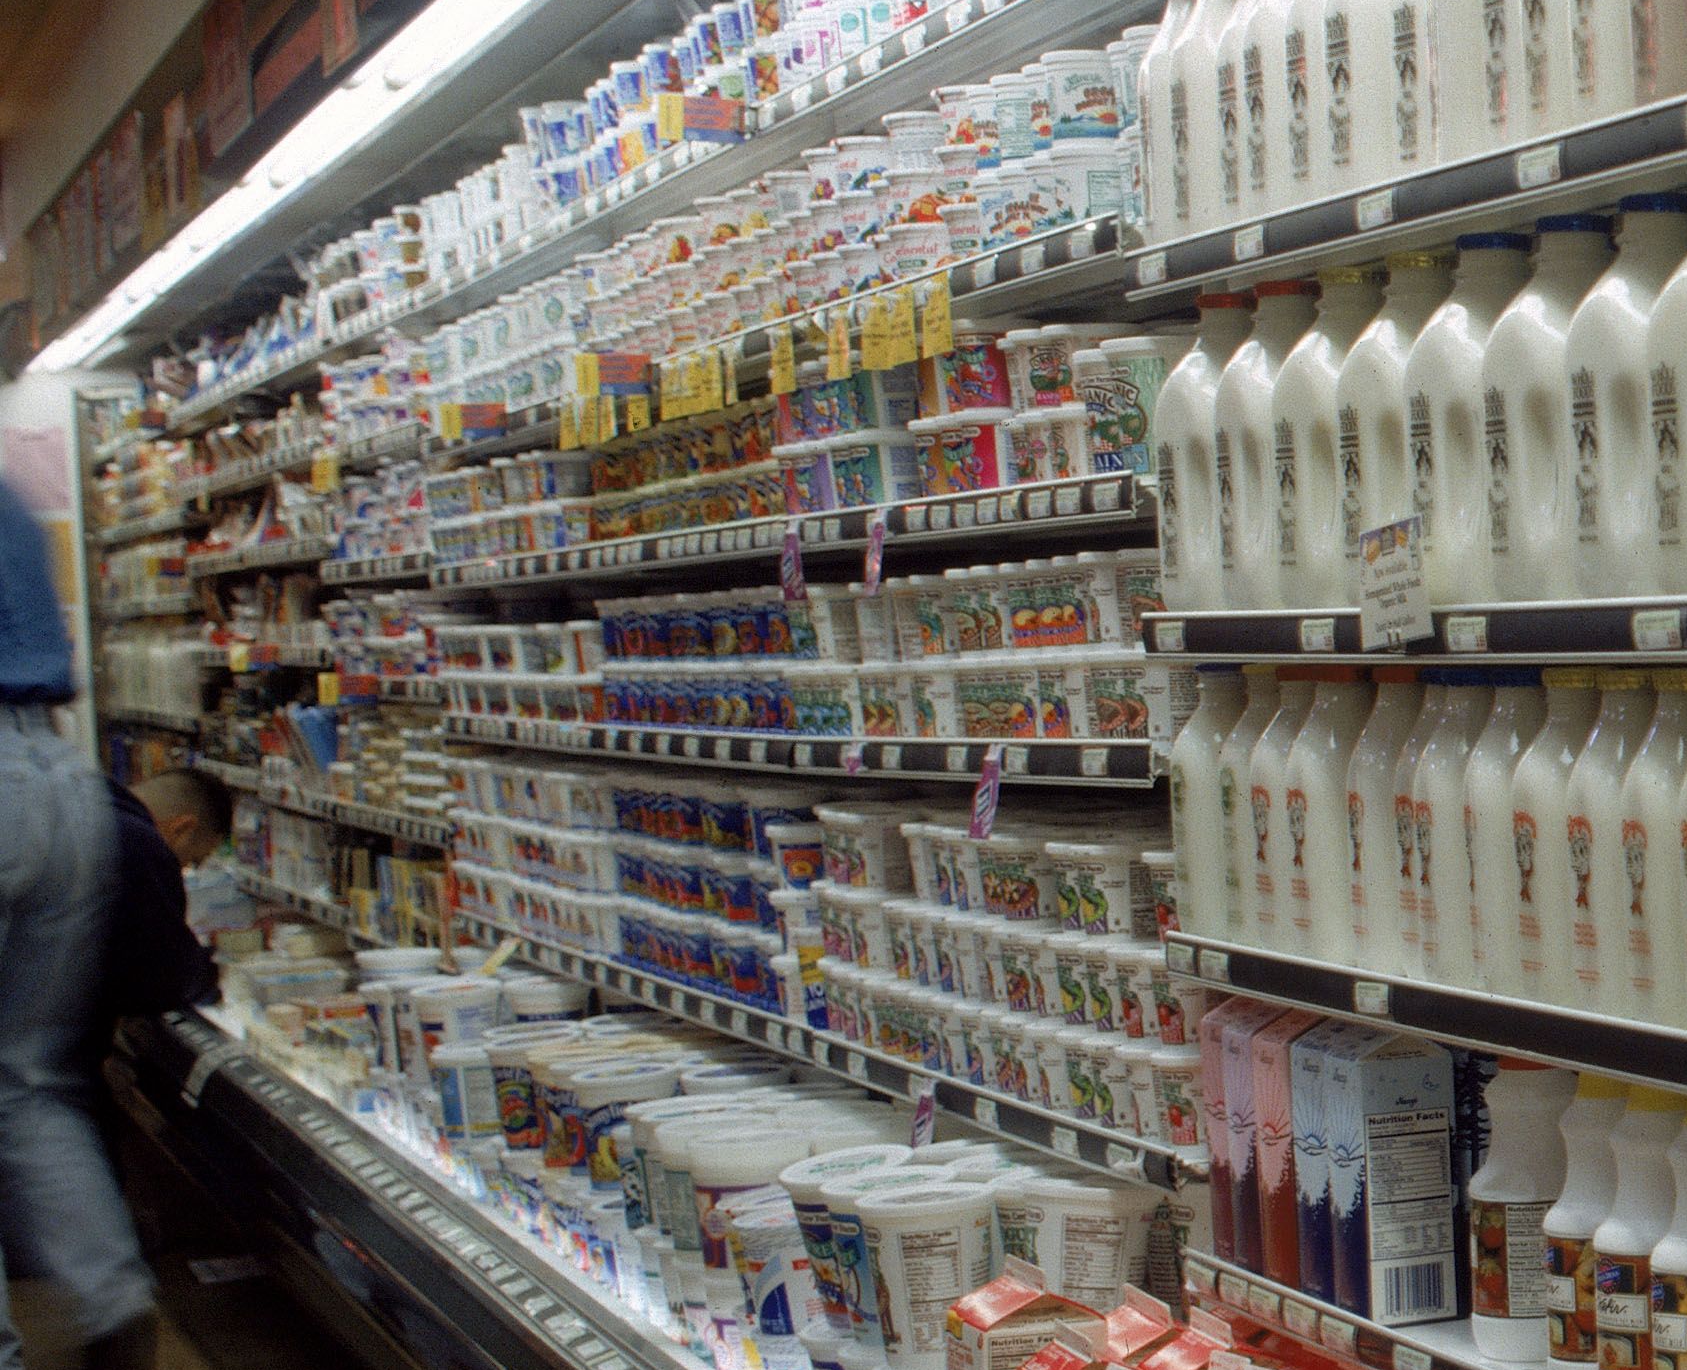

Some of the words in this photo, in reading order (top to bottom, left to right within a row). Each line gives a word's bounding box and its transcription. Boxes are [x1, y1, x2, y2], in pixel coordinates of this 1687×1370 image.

[1368, 1114, 1414, 1126] Nutrition
[1415, 1110, 1446, 1122] Facts
[990, 1336, 1036, 1348] Nutrition
